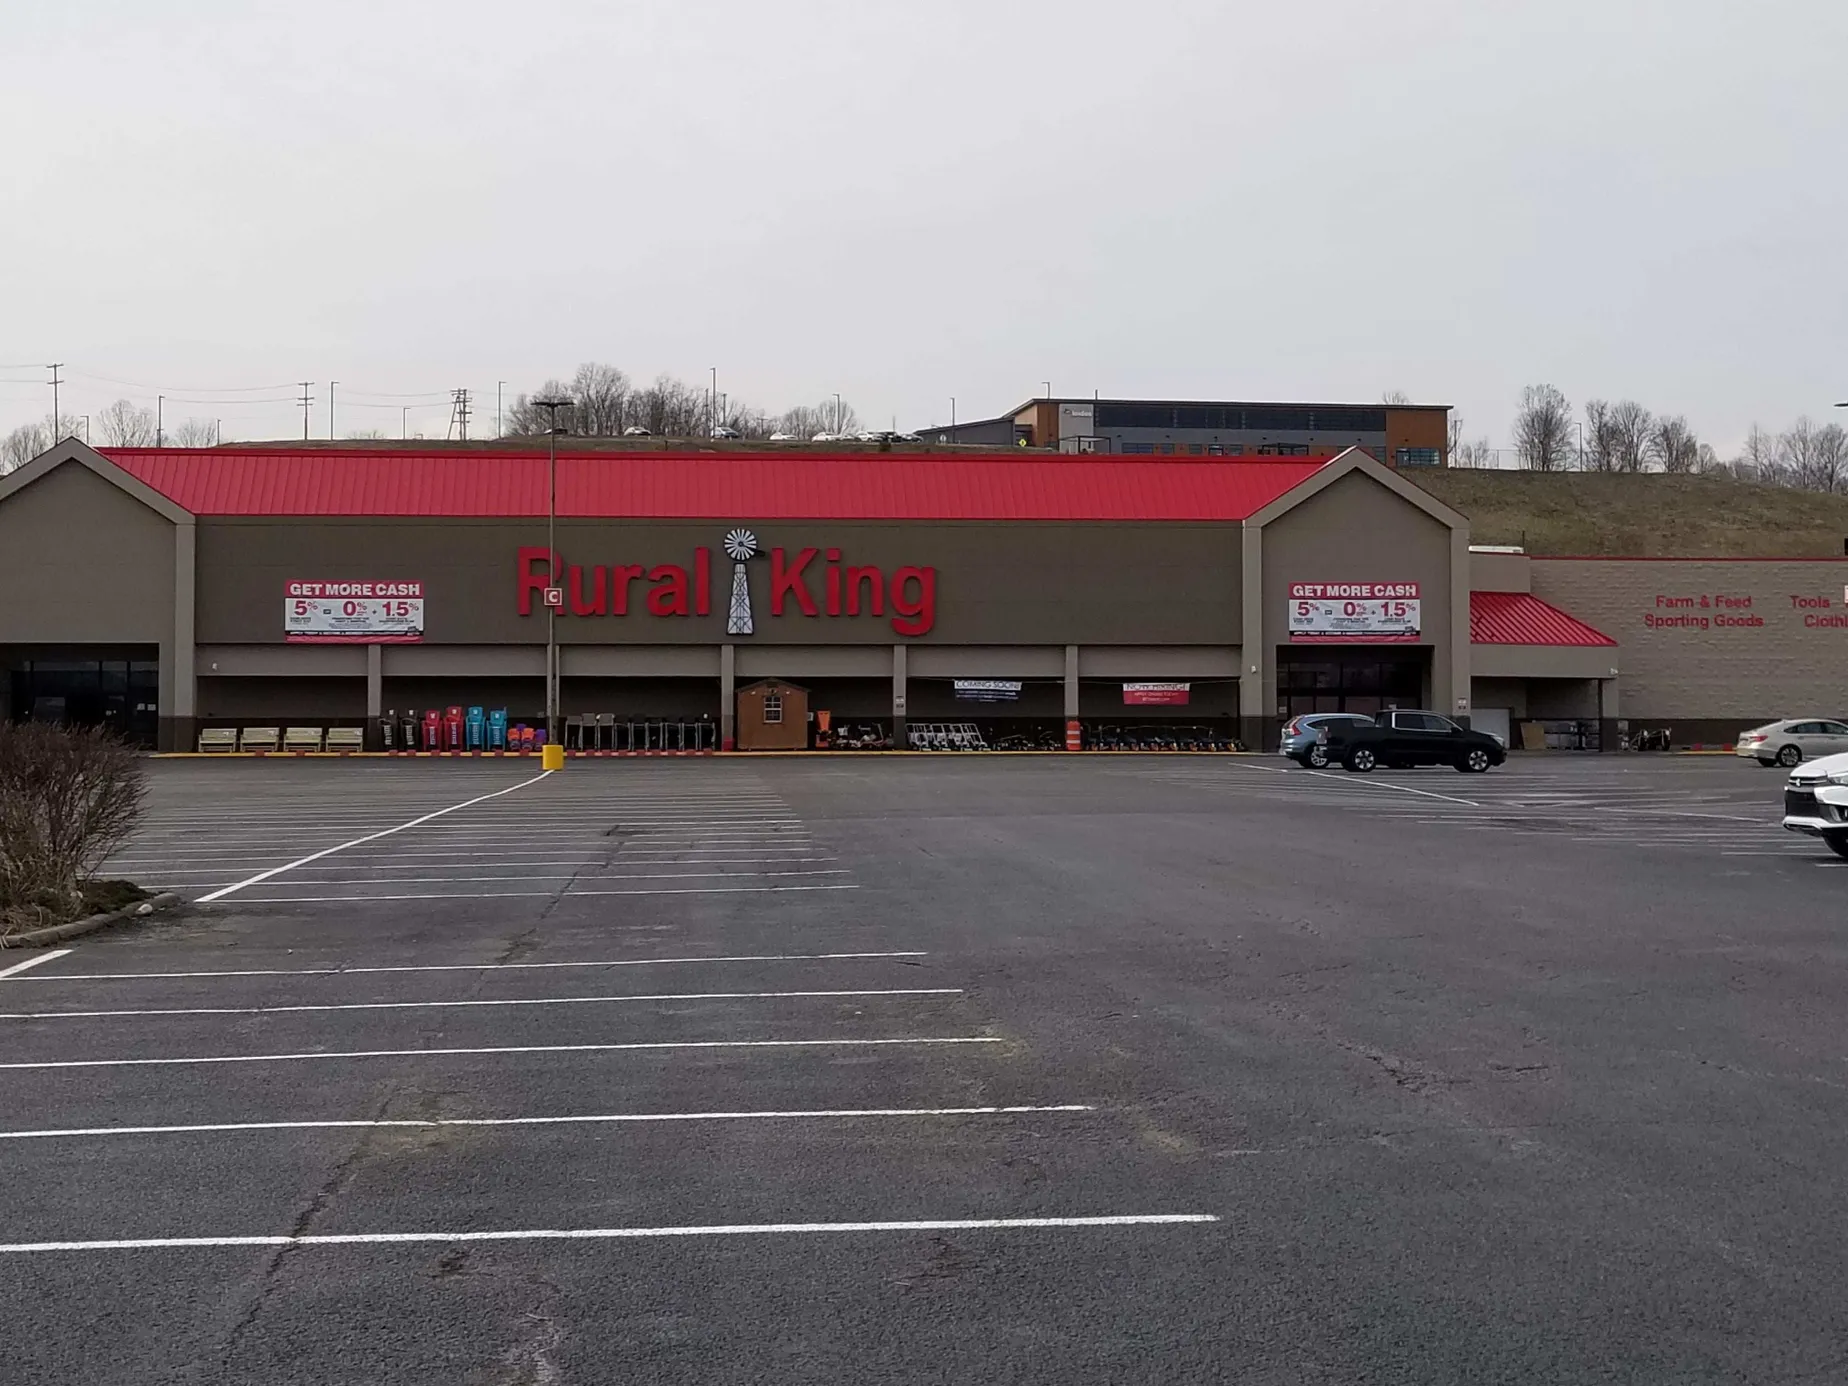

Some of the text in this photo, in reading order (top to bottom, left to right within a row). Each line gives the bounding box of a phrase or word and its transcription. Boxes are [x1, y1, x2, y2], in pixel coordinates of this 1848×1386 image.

[290, 583, 420, 596] GET MORE CASH
[516, 546, 937, 636] Rural King
[549, 591, 558, 603] C
[1292, 585, 1417, 597] GET MORE CASH
[294, 600, 318, 616] 5%
[382, 600, 420, 617] 1.5%
[1297, 601, 1320, 617] 5%
[1381, 601, 1417, 617] 1.5%
[1655, 594, 1752, 609] Farm & Feed
[1789, 595, 1830, 609] Tools
[1644, 614, 1765, 630] Sporting Goods
